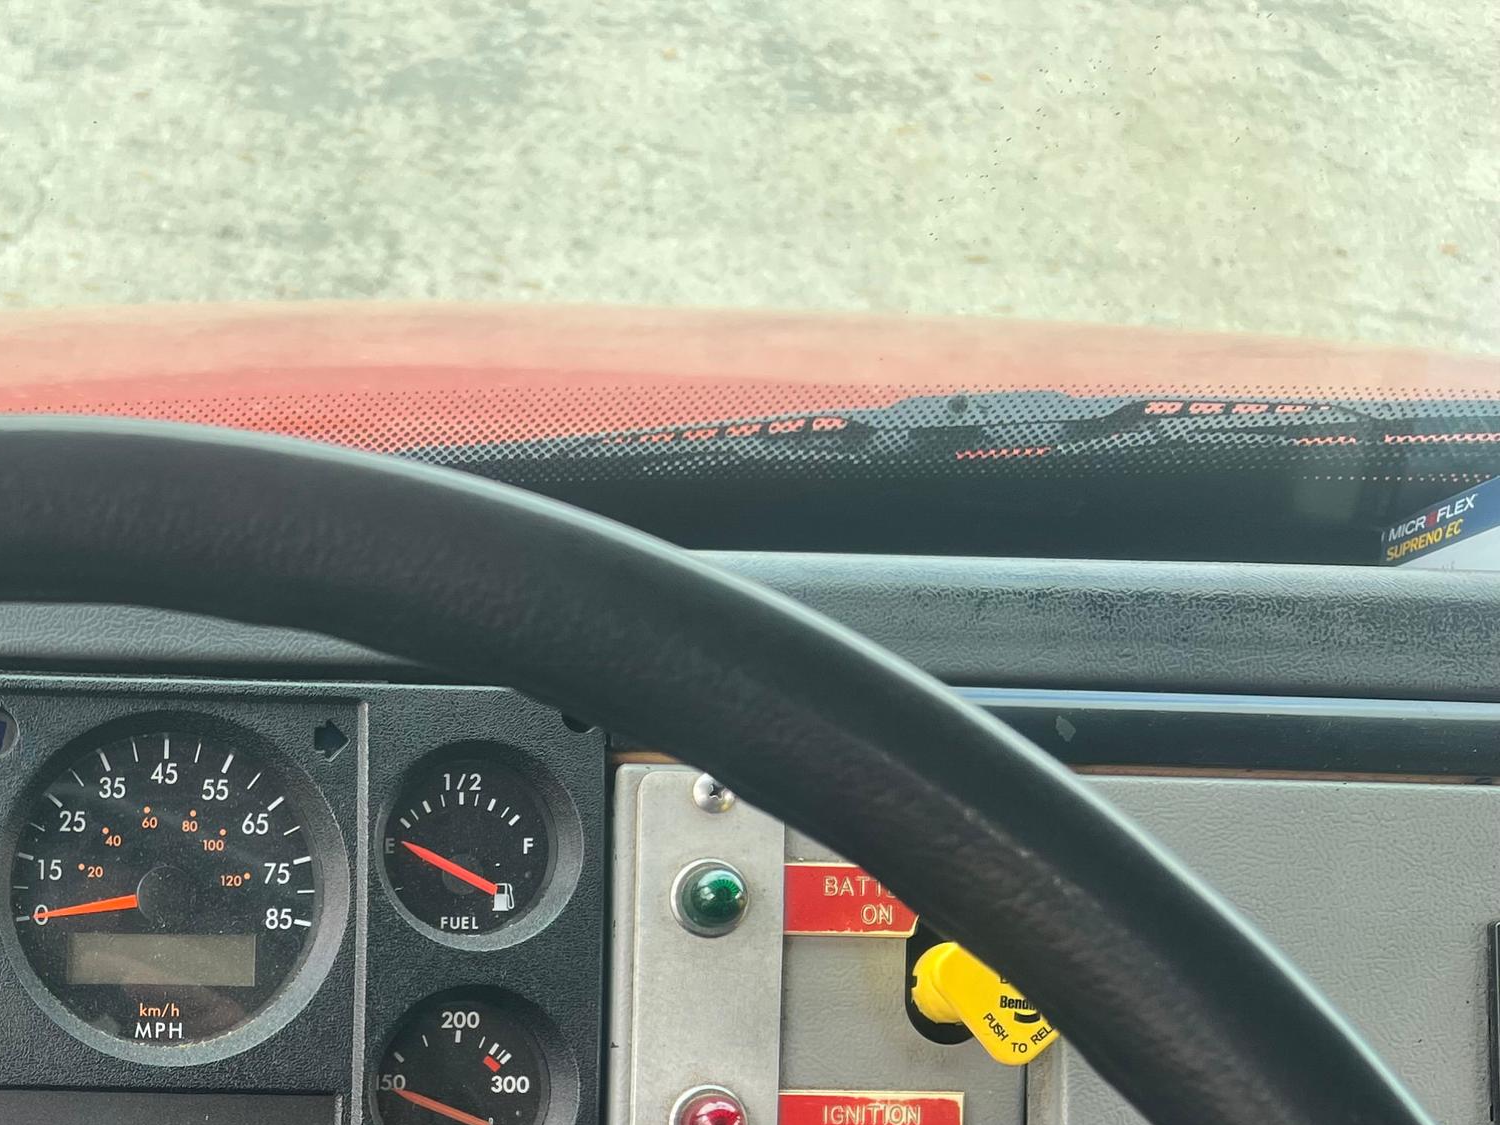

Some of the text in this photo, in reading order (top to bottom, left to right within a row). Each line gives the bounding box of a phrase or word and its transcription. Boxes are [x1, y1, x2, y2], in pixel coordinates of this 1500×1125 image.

[1386, 527, 1443, 561] SUPRENO
[151, 763, 178, 785] 45
[443, 773, 482, 791] 1/2
[99, 777, 126, 799] 35
[202, 779, 229, 801] 55
[59, 811, 87, 833] 25
[141, 817, 158, 830] 60
[182, 820, 199, 833] 80
[241, 813, 269, 836] 65
[105, 834, 122, 847] 40
[202, 839, 225, 852] 100
[385, 837, 395, 854] E
[523, 837, 534, 855] F
[37, 859, 63, 881] 15
[87, 865, 104, 878] 20
[264, 863, 290, 885] 75
[220, 875, 242, 887] 120
[34, 904, 49, 925] 0
[265, 908, 293, 930] 85
[440, 916, 479, 930] FUEL
[861, 904, 893, 925] ON
[139, 1002, 180, 1019] km/h
[999, 995, 1037, 1011] Bend
[441, 1011, 480, 1029] 200
[135, 1022, 184, 1039] MPH
[983, 1012, 1054, 1053] PUSH TO REL
[491, 1075, 530, 1093] 300
